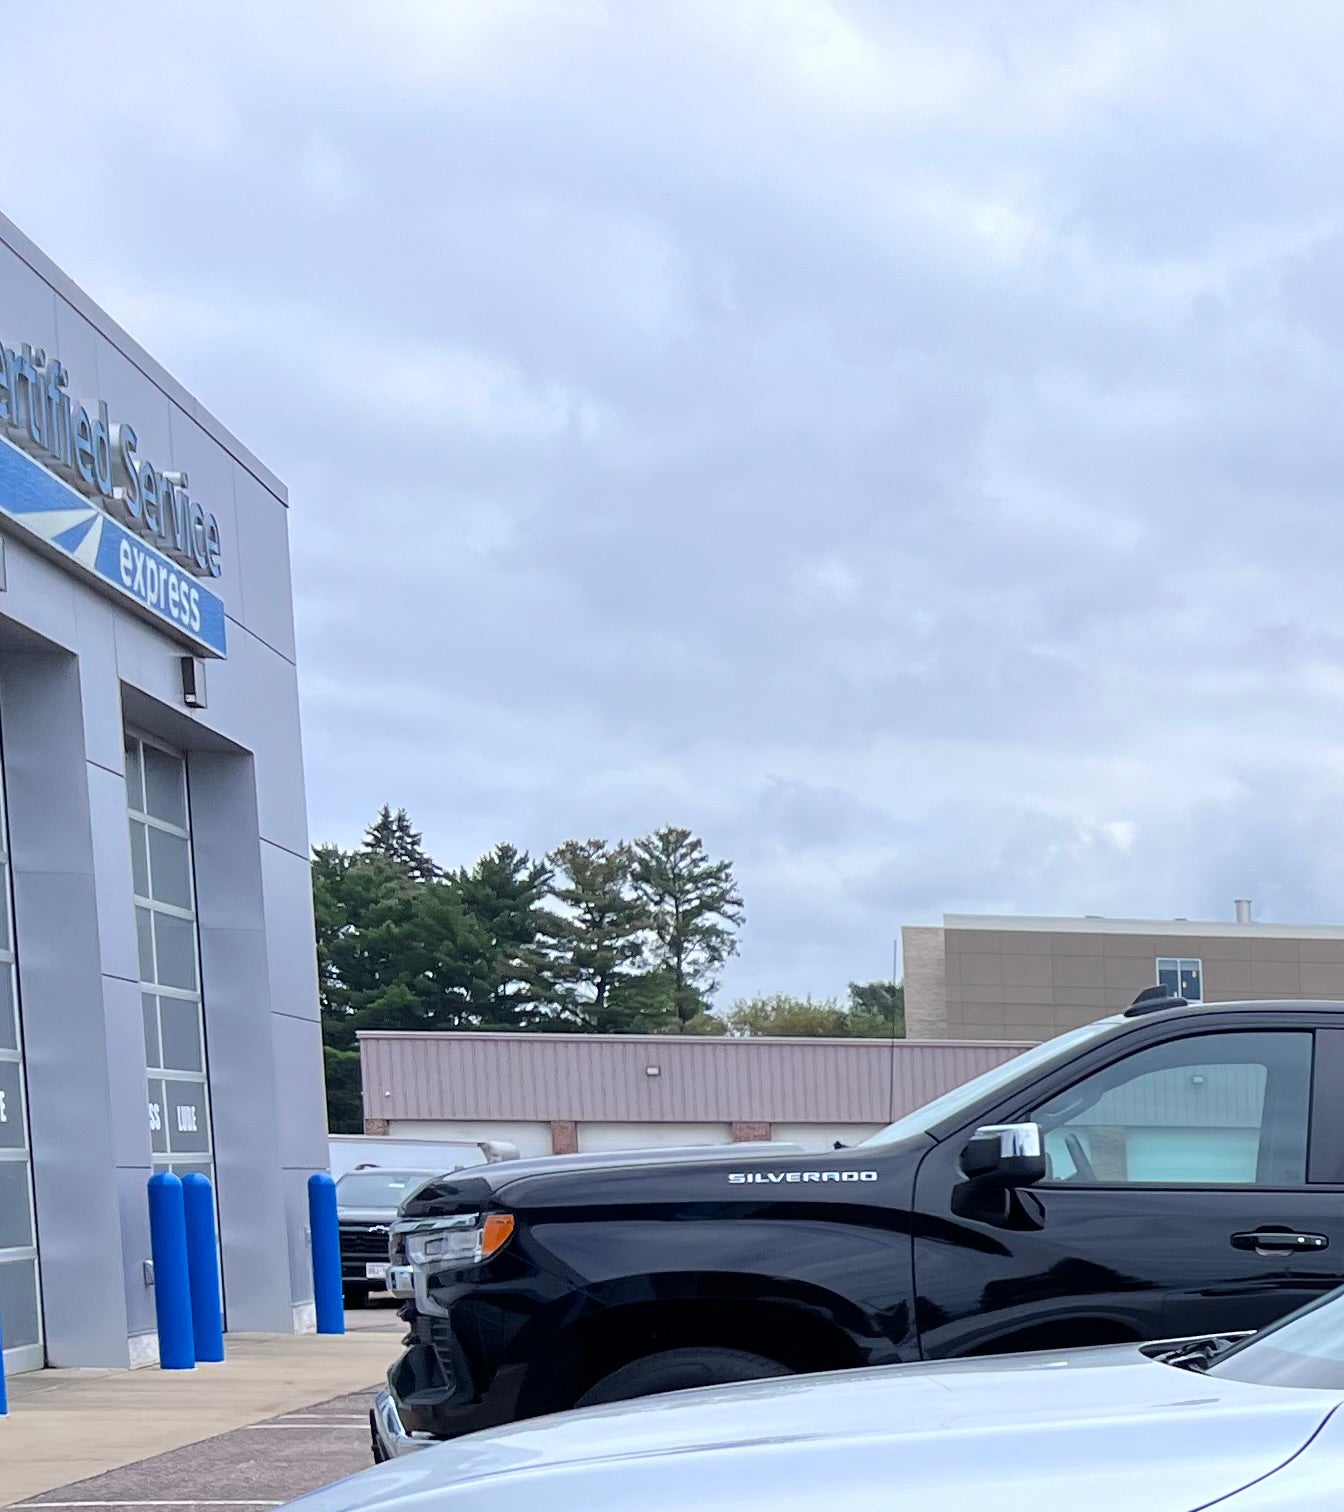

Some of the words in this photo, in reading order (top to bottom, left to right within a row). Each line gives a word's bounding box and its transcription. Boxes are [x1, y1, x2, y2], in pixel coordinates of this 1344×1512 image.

[117, 423, 222, 578] Service
[119, 538, 200, 633] express
[727, 1171, 878, 1184] SILVERADO
